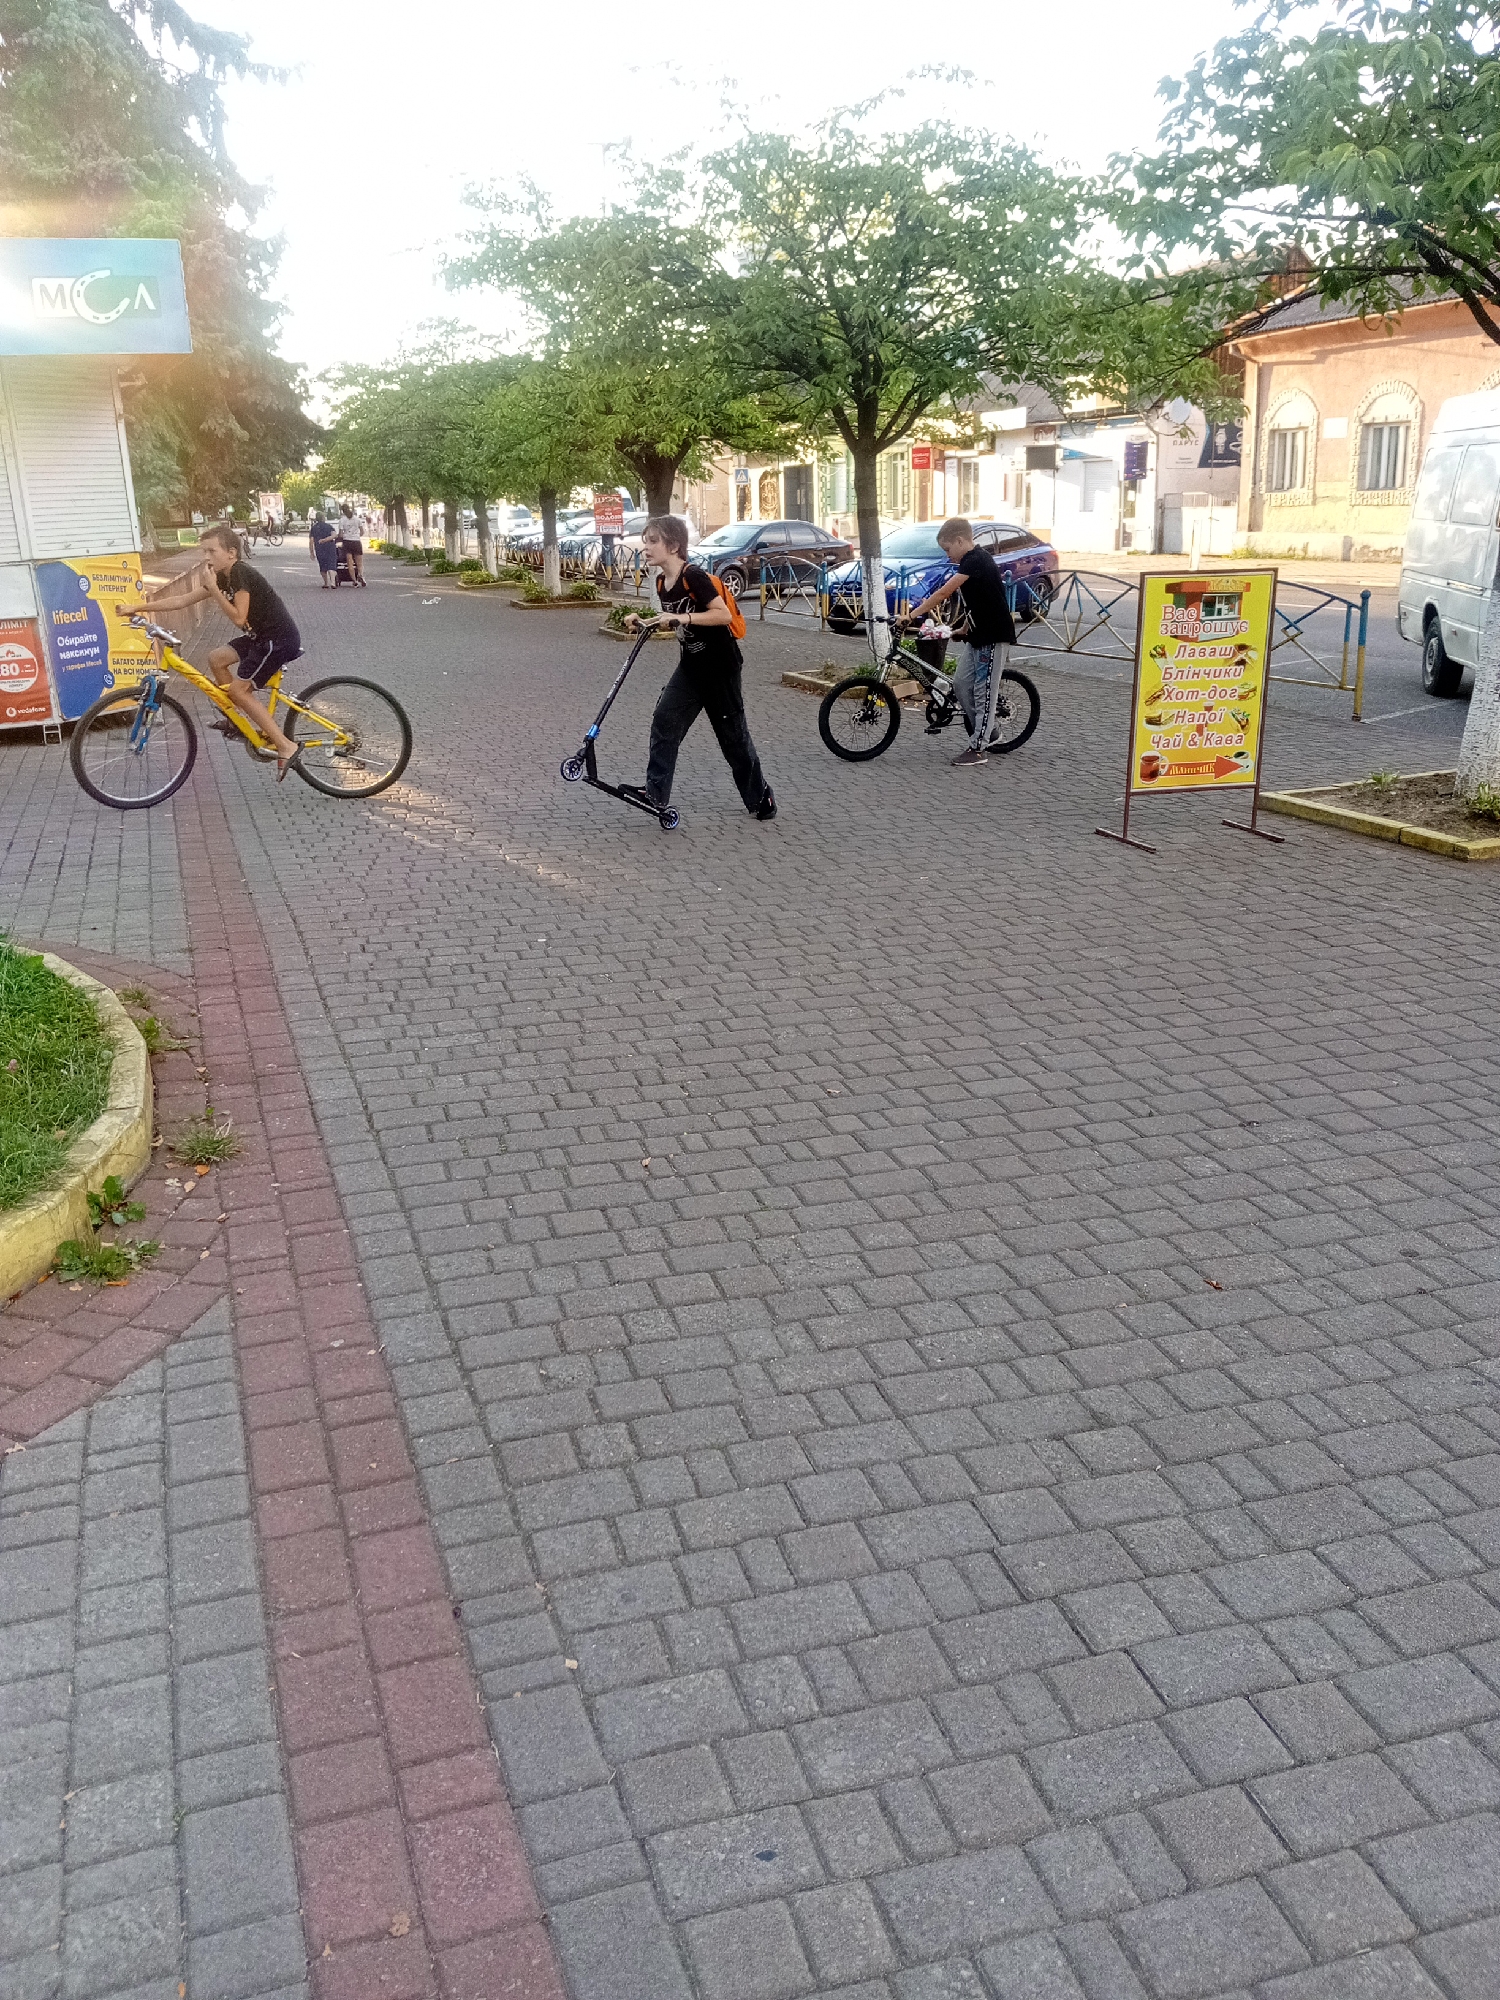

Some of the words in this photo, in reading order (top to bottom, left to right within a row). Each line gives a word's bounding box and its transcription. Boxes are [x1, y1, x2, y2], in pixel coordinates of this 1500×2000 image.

[98, 585, 127, 593] ІНТЕРНЕТ
[52, 607, 88, 624] lifecell
[1162, 605, 1197, 621] Вас
[1160, 620, 1249, 637] запрошує
[57, 633, 98, 647] Обирайте
[59, 646, 100, 660] максимум
[1175, 645, 1234, 659] Лаваш
[112, 658, 135, 666] БАГАТО
[1162, 666, 1243, 681] Блінчики
[1163, 685, 1239, 701] Хот-дог
[1175, 708, 1227, 725] Напої
[1151, 734, 1182, 749] Чай
[1188, 733, 1198, 748] &
[1204, 732, 1244, 747] Кава
